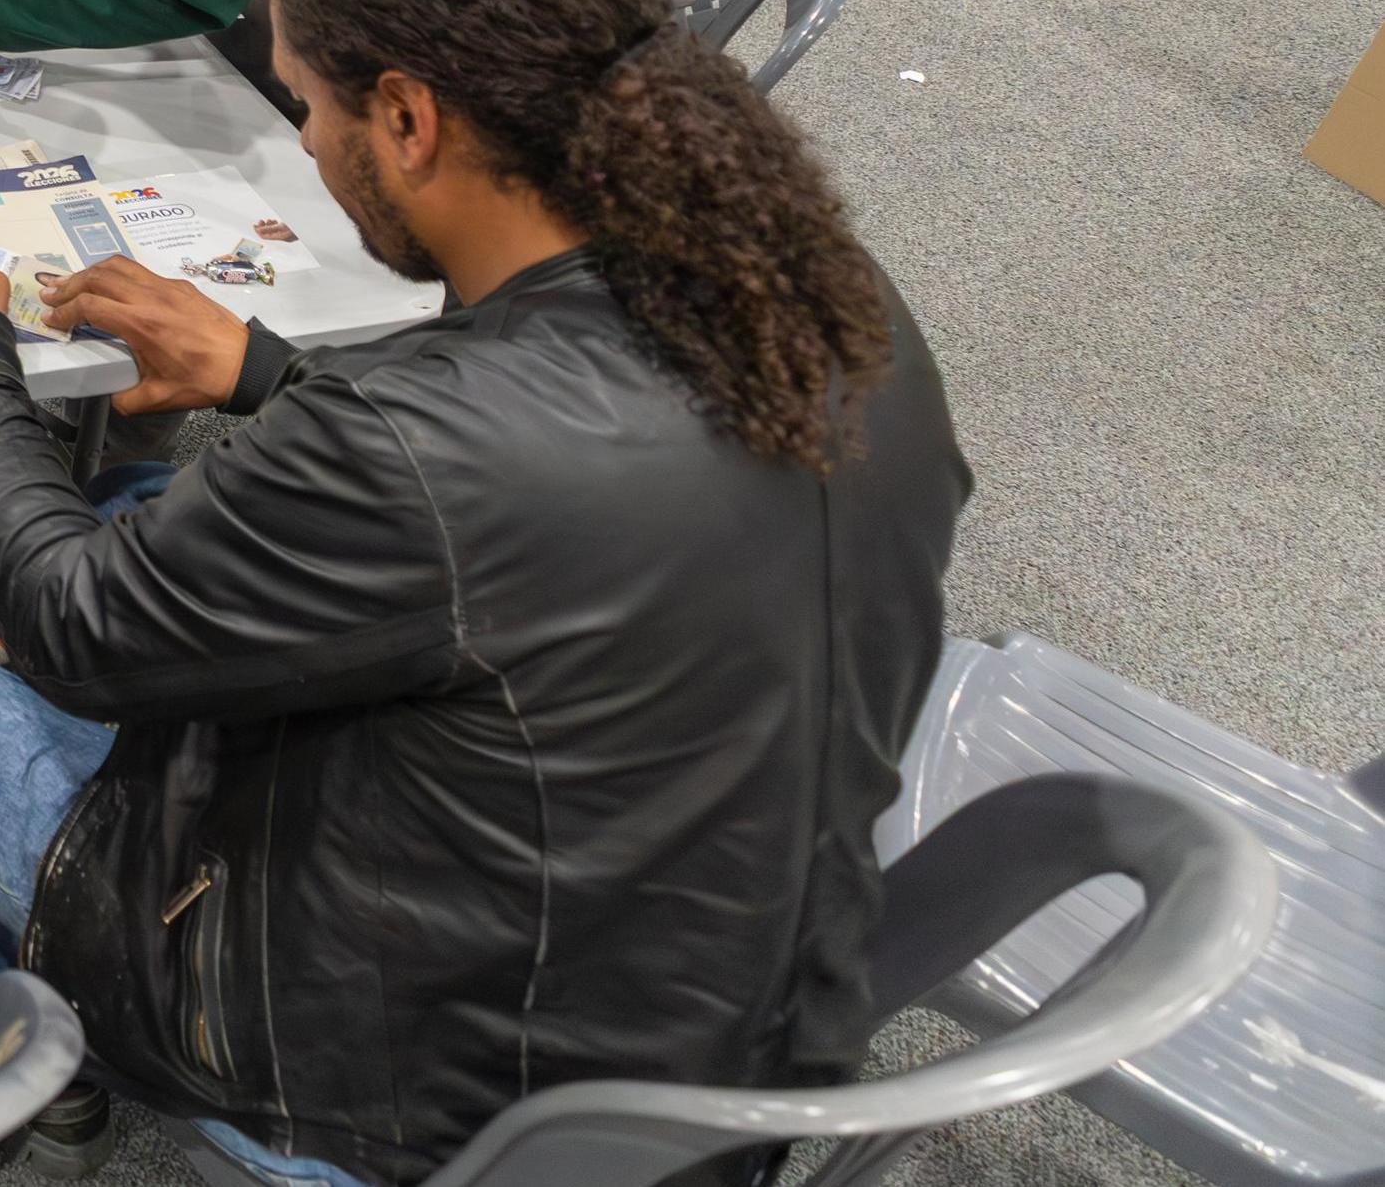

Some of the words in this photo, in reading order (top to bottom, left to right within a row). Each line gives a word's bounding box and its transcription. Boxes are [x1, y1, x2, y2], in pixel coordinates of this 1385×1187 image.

[17, 164, 81, 185] 2026
[24, 175, 82, 188] ELECCIONES
[109, 187, 161, 202] 2026
[119, 207, 184, 224] JURADO
